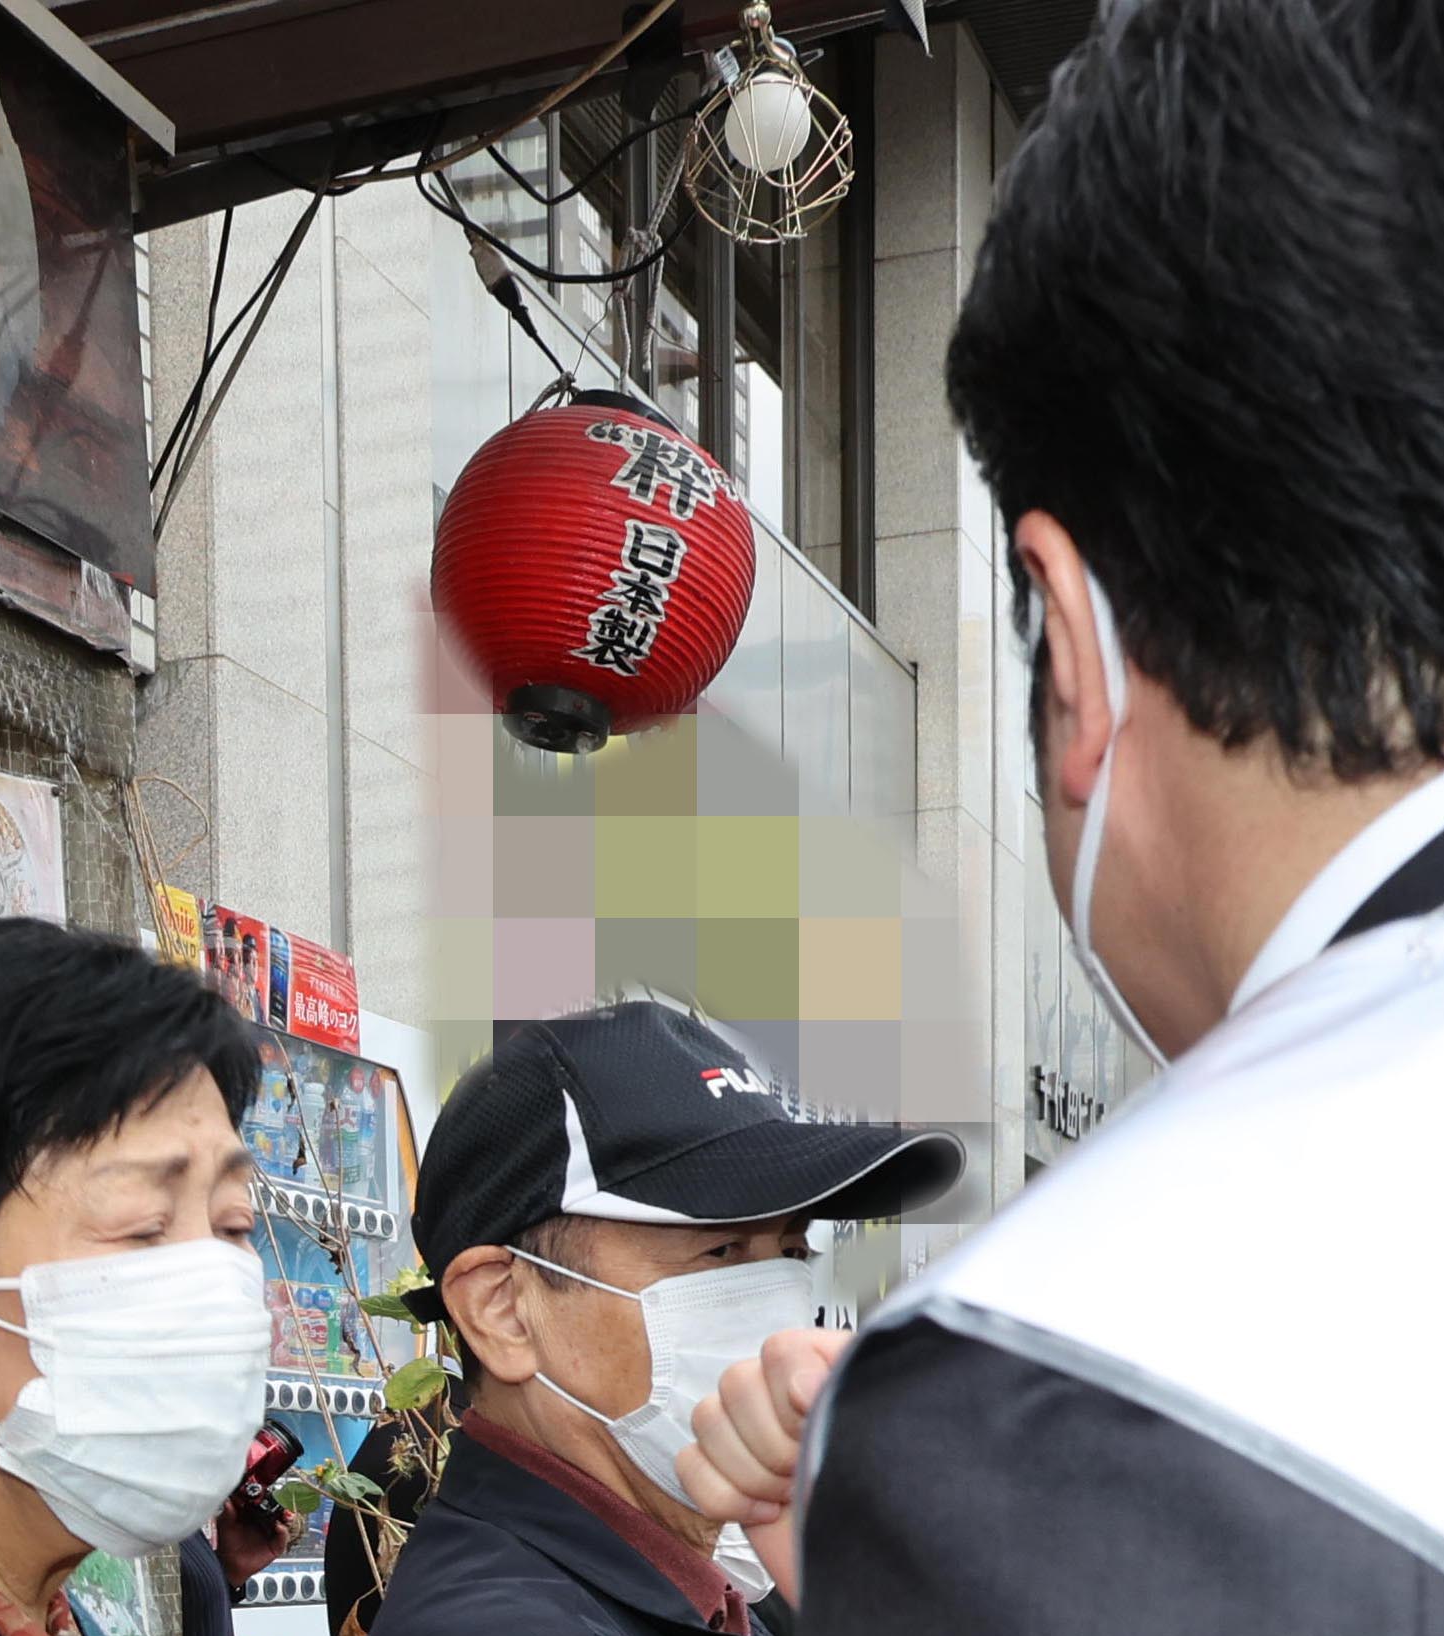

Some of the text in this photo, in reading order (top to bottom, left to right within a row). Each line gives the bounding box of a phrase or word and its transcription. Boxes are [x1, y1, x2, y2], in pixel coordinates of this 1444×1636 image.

[571, 520, 686, 675] 日本製
[294, 990, 358, 1036] 最高峰のコク
[699, 1067, 770, 1099] FILA
